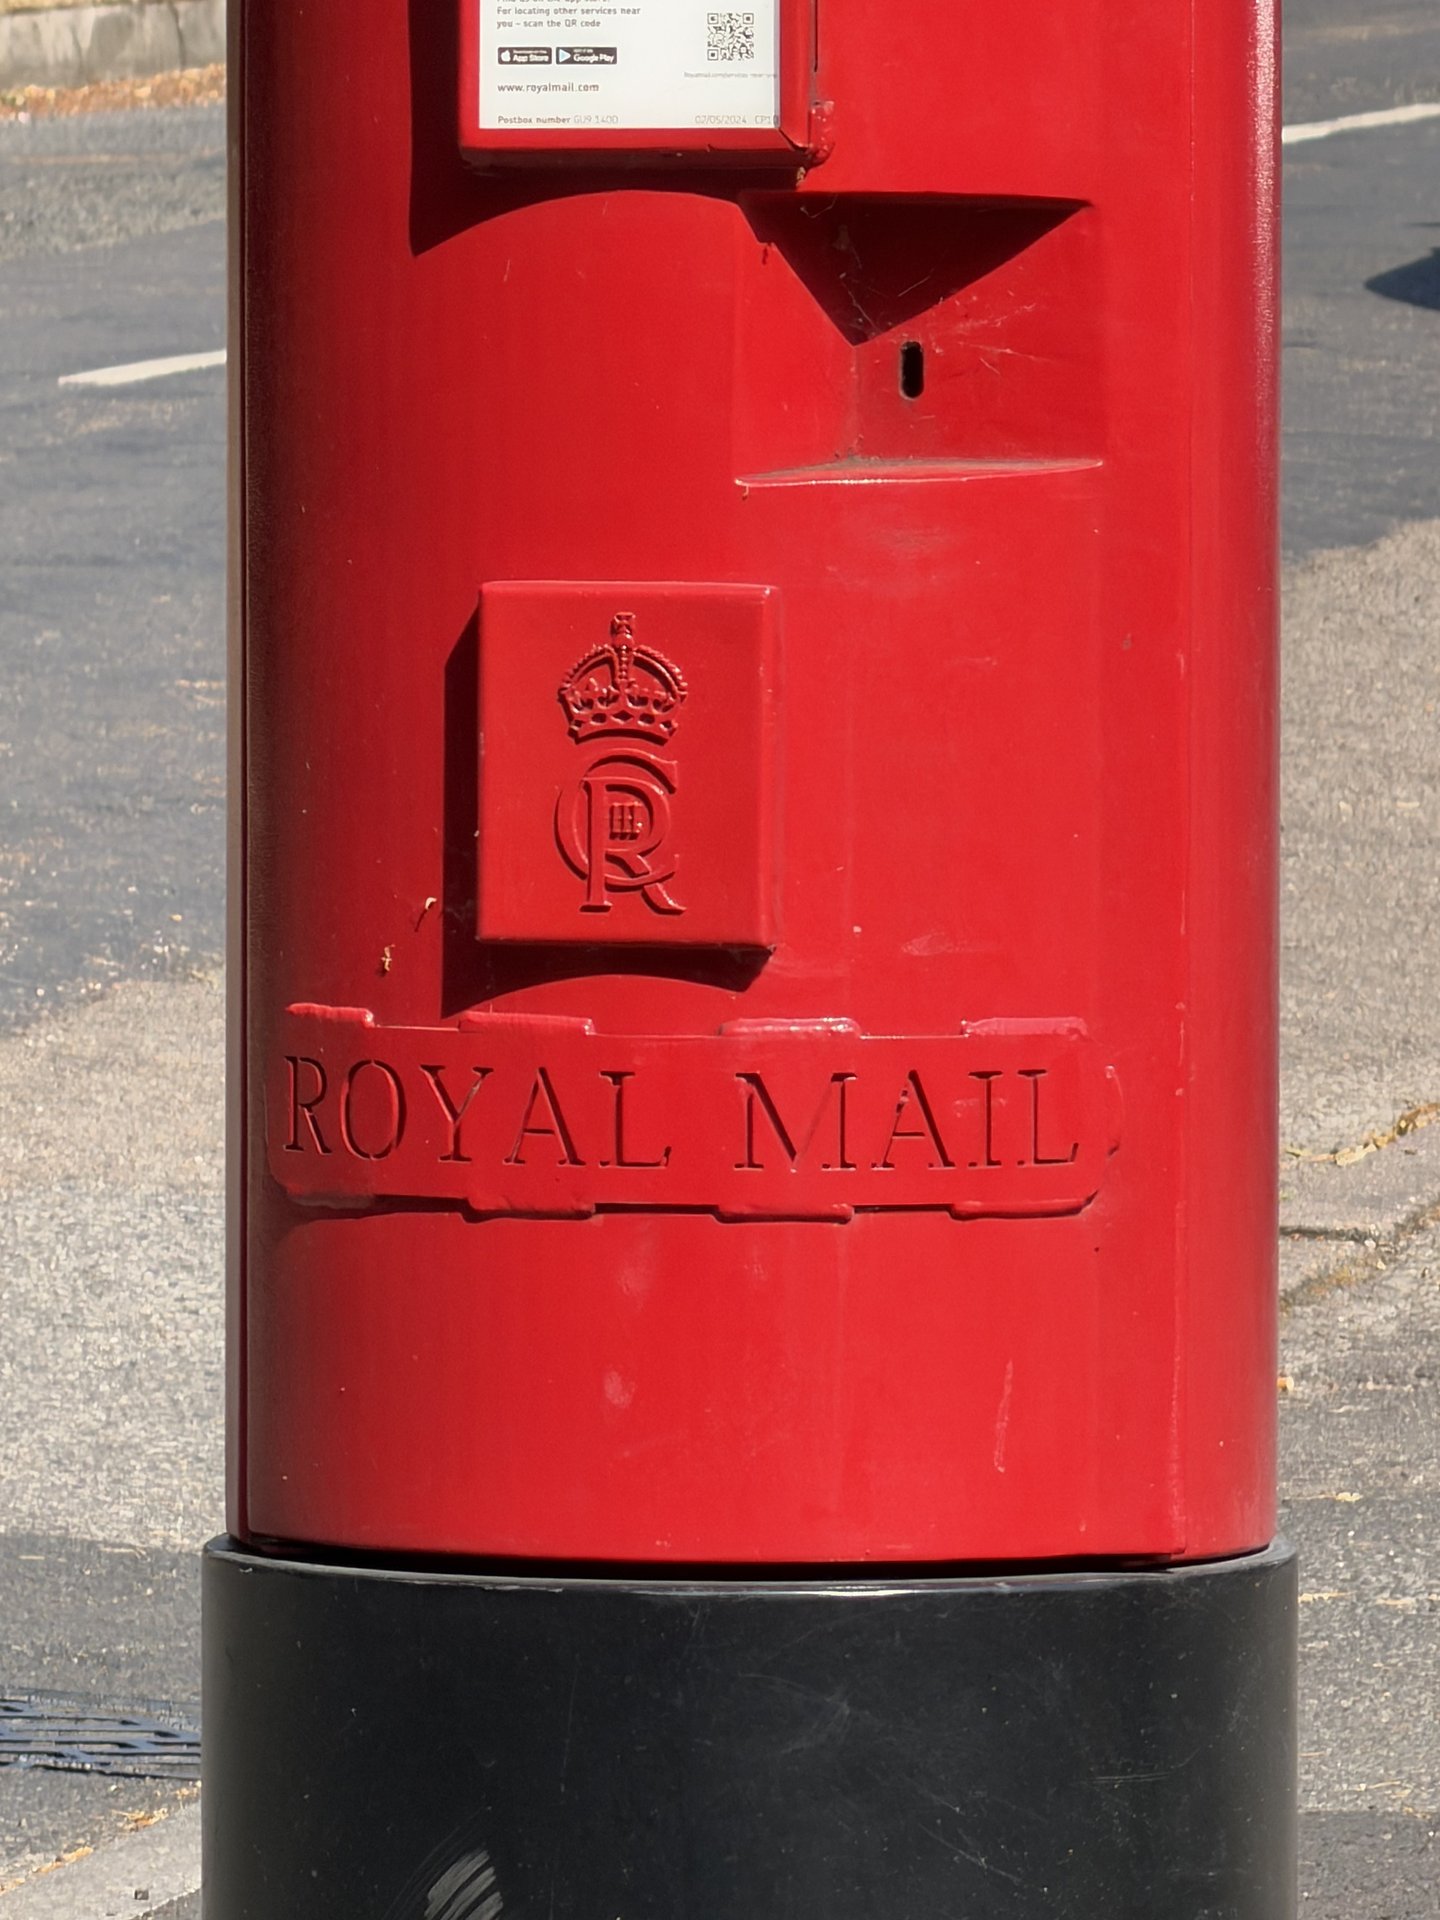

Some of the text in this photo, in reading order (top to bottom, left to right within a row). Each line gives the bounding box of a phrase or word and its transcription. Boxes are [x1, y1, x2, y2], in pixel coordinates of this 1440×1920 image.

[497, 7, 511, 15] For
[514, 6, 550, 16] locating
[554, 6, 577, 15] other
[581, 6, 617, 15] services
[497, 20, 513, 29] you
[524, 20, 543, 28] scan
[547, 19, 561, 28] the
[565, 19, 577, 28] QR
[580, 19, 601, 28] code
[573, 54, 614, 63] Google Play
[497, 82, 600, 94] www.royalmail.com
[498, 115, 533, 124] Postbox
[536, 115, 571, 124] number
[283, 1054, 1081, 1172] ROYAL MAIL
